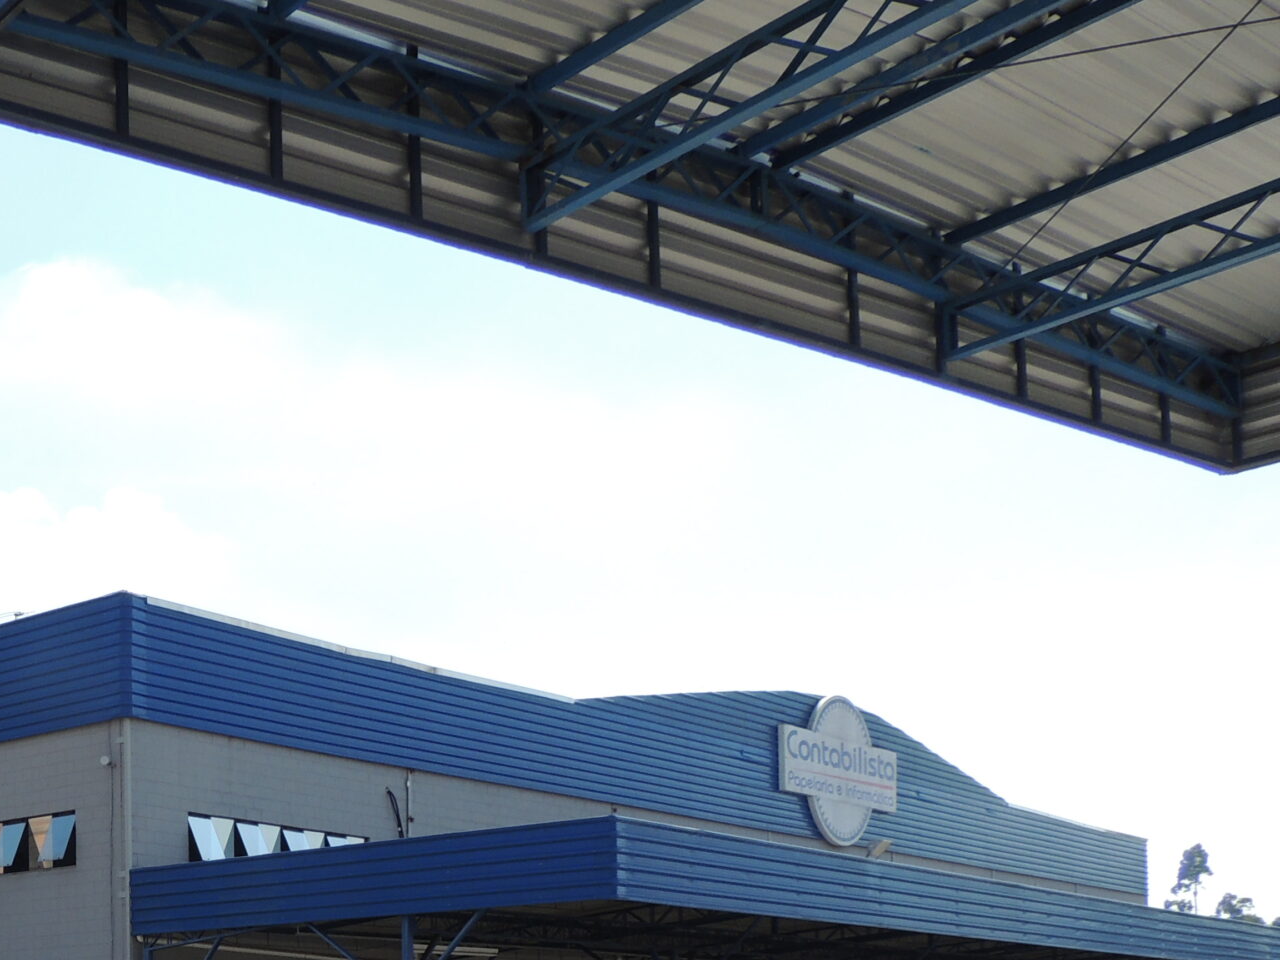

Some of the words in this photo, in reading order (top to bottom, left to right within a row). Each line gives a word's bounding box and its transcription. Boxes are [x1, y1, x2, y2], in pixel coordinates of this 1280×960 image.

[786, 729, 895, 782] Contabilista
[787, 770, 834, 794] Papelaria
[836, 784, 843, 796] e
